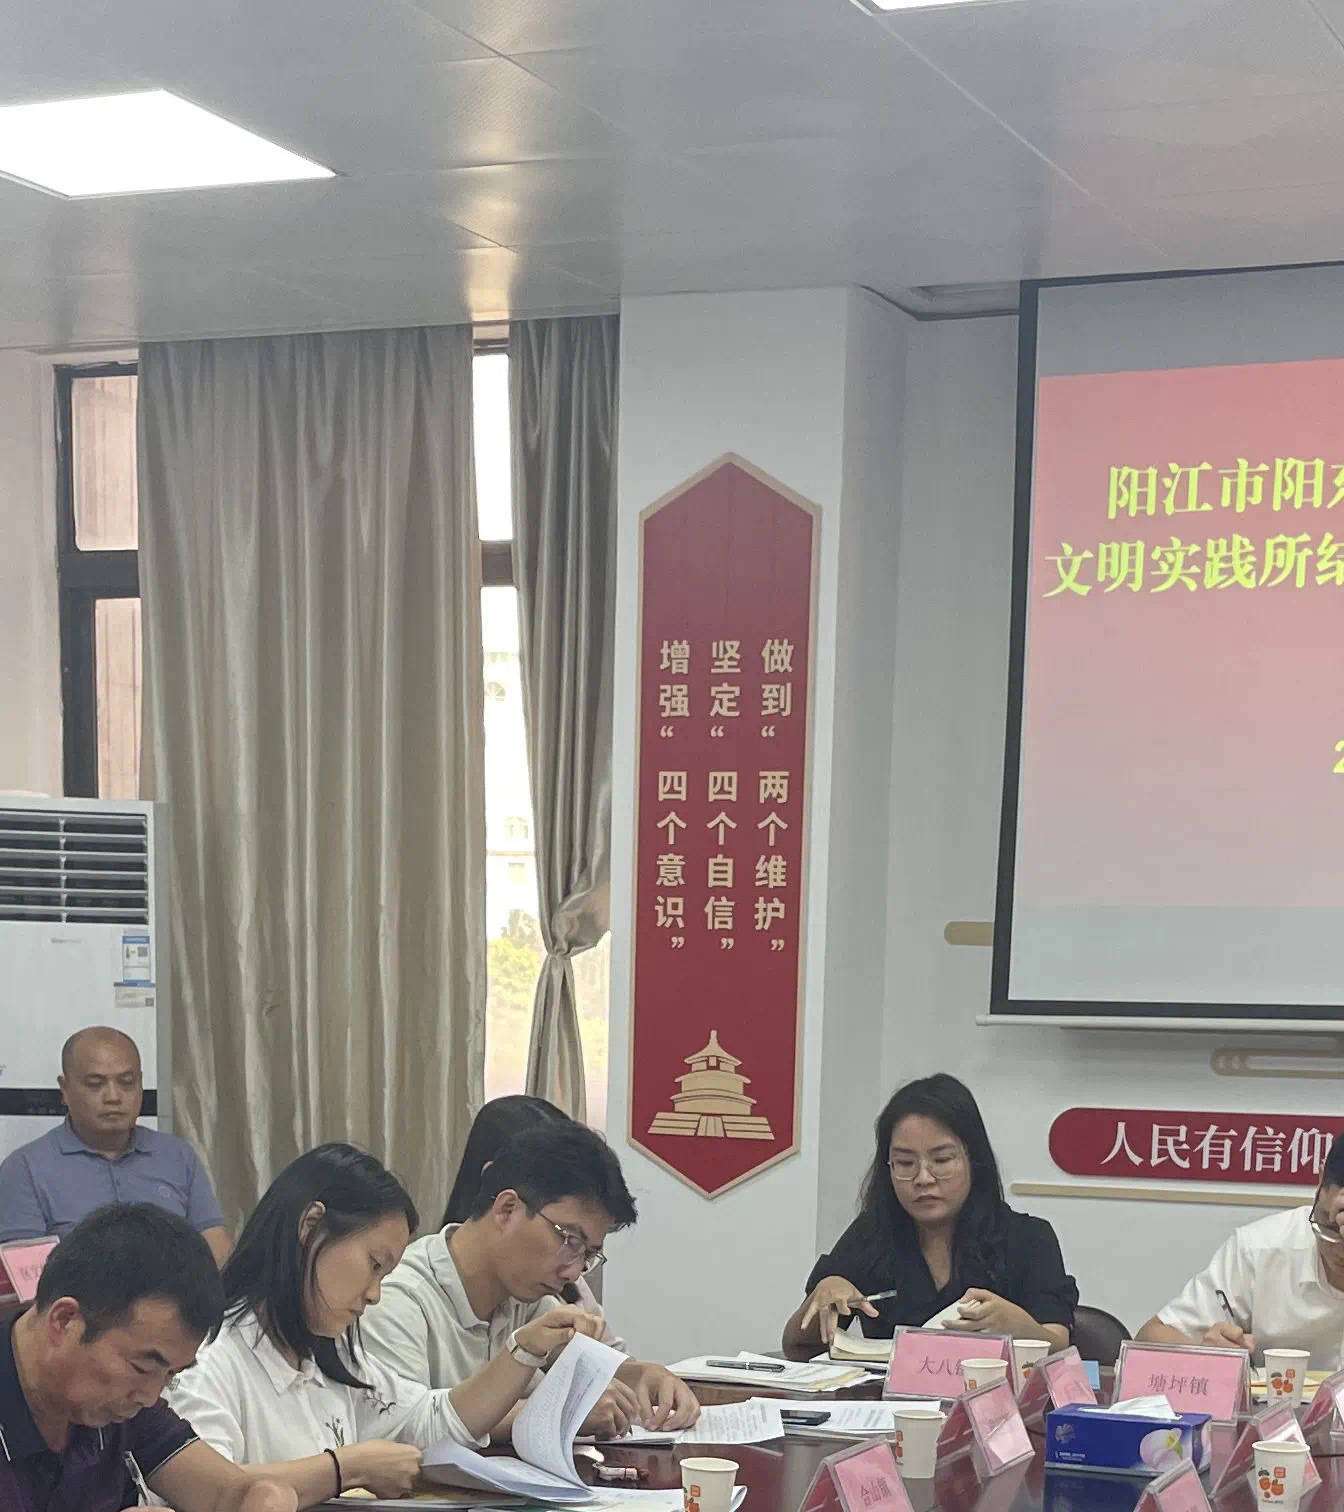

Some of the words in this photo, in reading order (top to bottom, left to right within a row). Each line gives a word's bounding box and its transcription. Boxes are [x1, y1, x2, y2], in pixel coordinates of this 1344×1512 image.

[655, 640, 691, 950] 增强“四个意识”
[703, 640, 742, 951] 坚定“四个自信”
[754, 639, 794, 952] 做到“两个维护”
[1100, 1121, 1334, 1174] 人民有信仰
[1149, 1373, 1210, 1397] 塘坪镇
[861, 1477, 892, 1506] 合山镇
